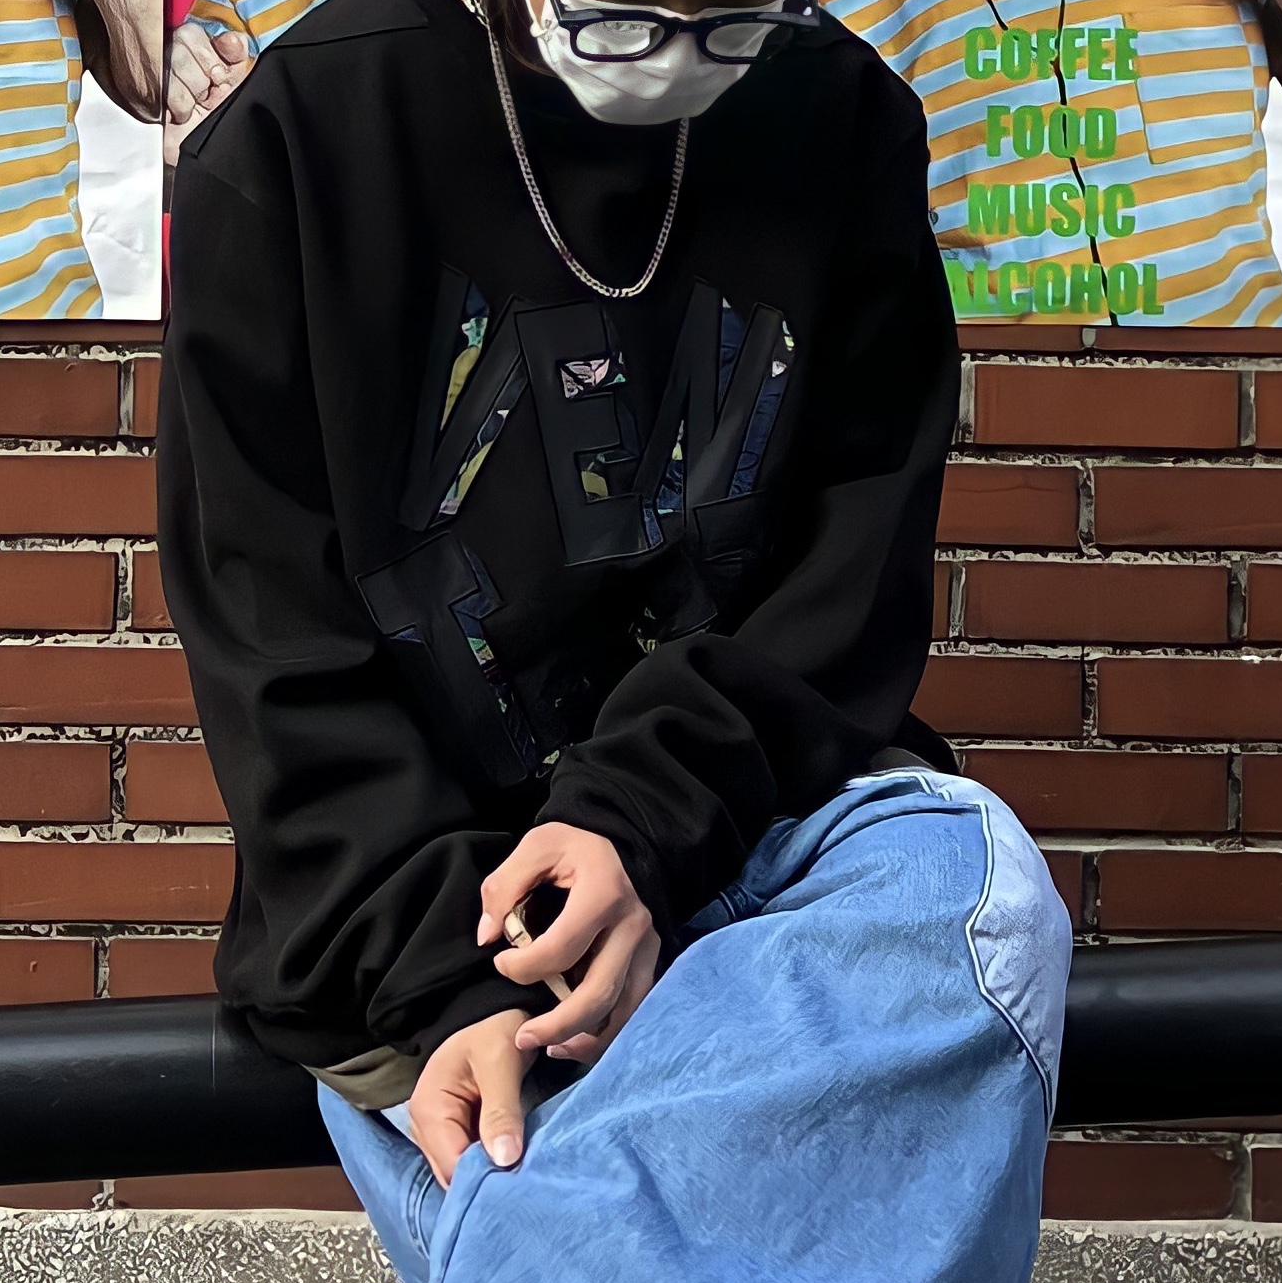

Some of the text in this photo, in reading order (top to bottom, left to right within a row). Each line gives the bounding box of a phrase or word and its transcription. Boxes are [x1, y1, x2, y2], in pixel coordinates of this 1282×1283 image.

[964, 26, 1139, 82] COFFEE
[985, 106, 1117, 158] FOOD
[966, 183, 1135, 239] MUSIC
